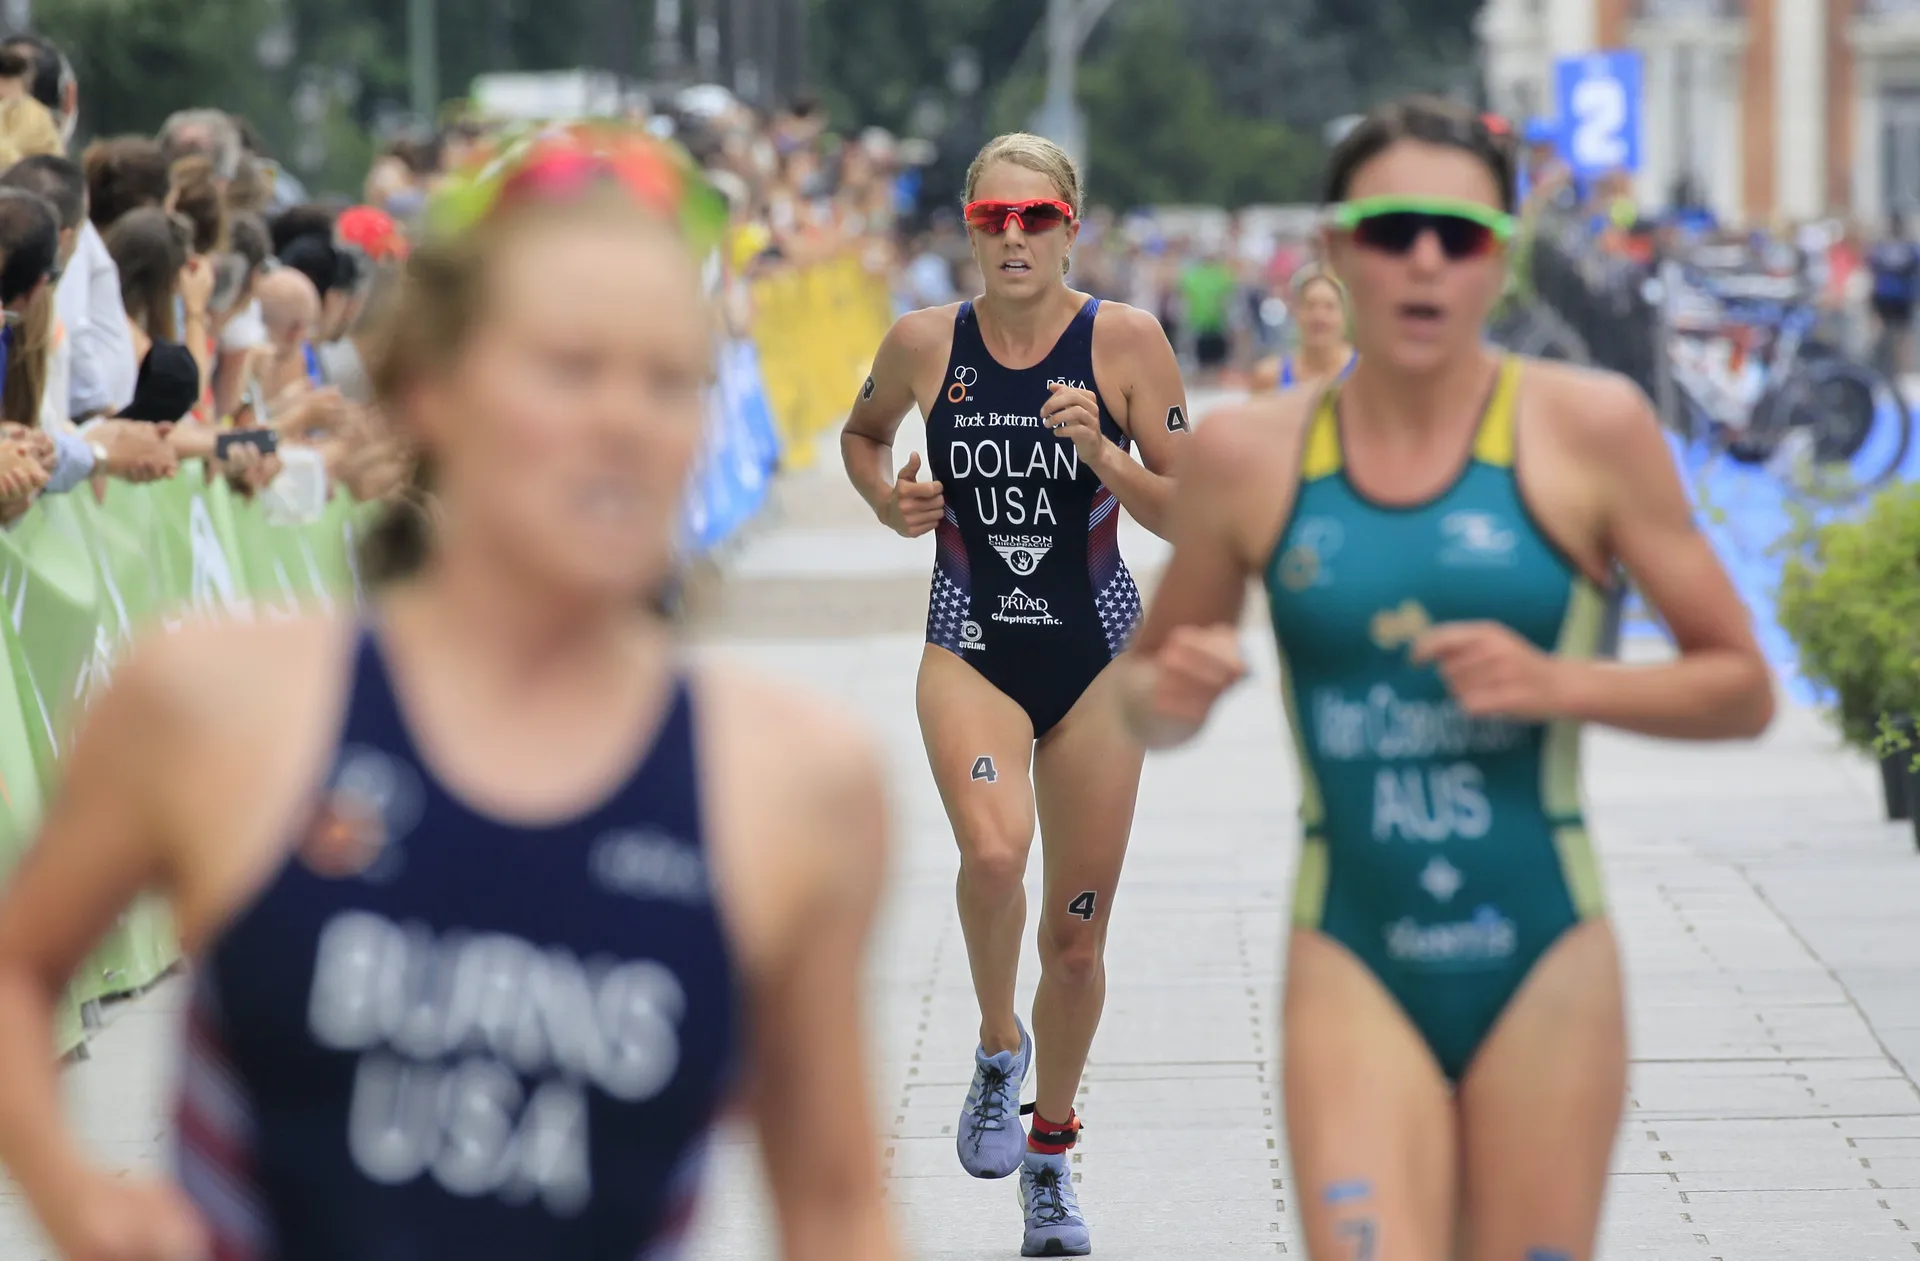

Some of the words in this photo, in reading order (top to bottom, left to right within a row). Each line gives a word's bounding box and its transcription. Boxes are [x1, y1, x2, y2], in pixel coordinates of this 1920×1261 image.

[1573, 79, 1627, 164] 2
[954, 412, 985, 428] Rock
[988, 413, 1039, 428] Bottom
[1165, 404, 1190, 434] 4
[950, 440, 1078, 481] DOLAN
[975, 487, 1057, 525] USA
[988, 534, 1053, 543] MUNSON
[998, 595, 1048, 610] TRIAD
[1043, 617, 1063, 625] Inc.
[959, 641, 986, 651] CYCLING
[970, 756, 998, 783] 4
[1371, 764, 1491, 841] AUS
[1067, 891, 1097, 921] 4
[307, 909, 687, 1102] BURNS
[347, 1050, 592, 1218] USA
